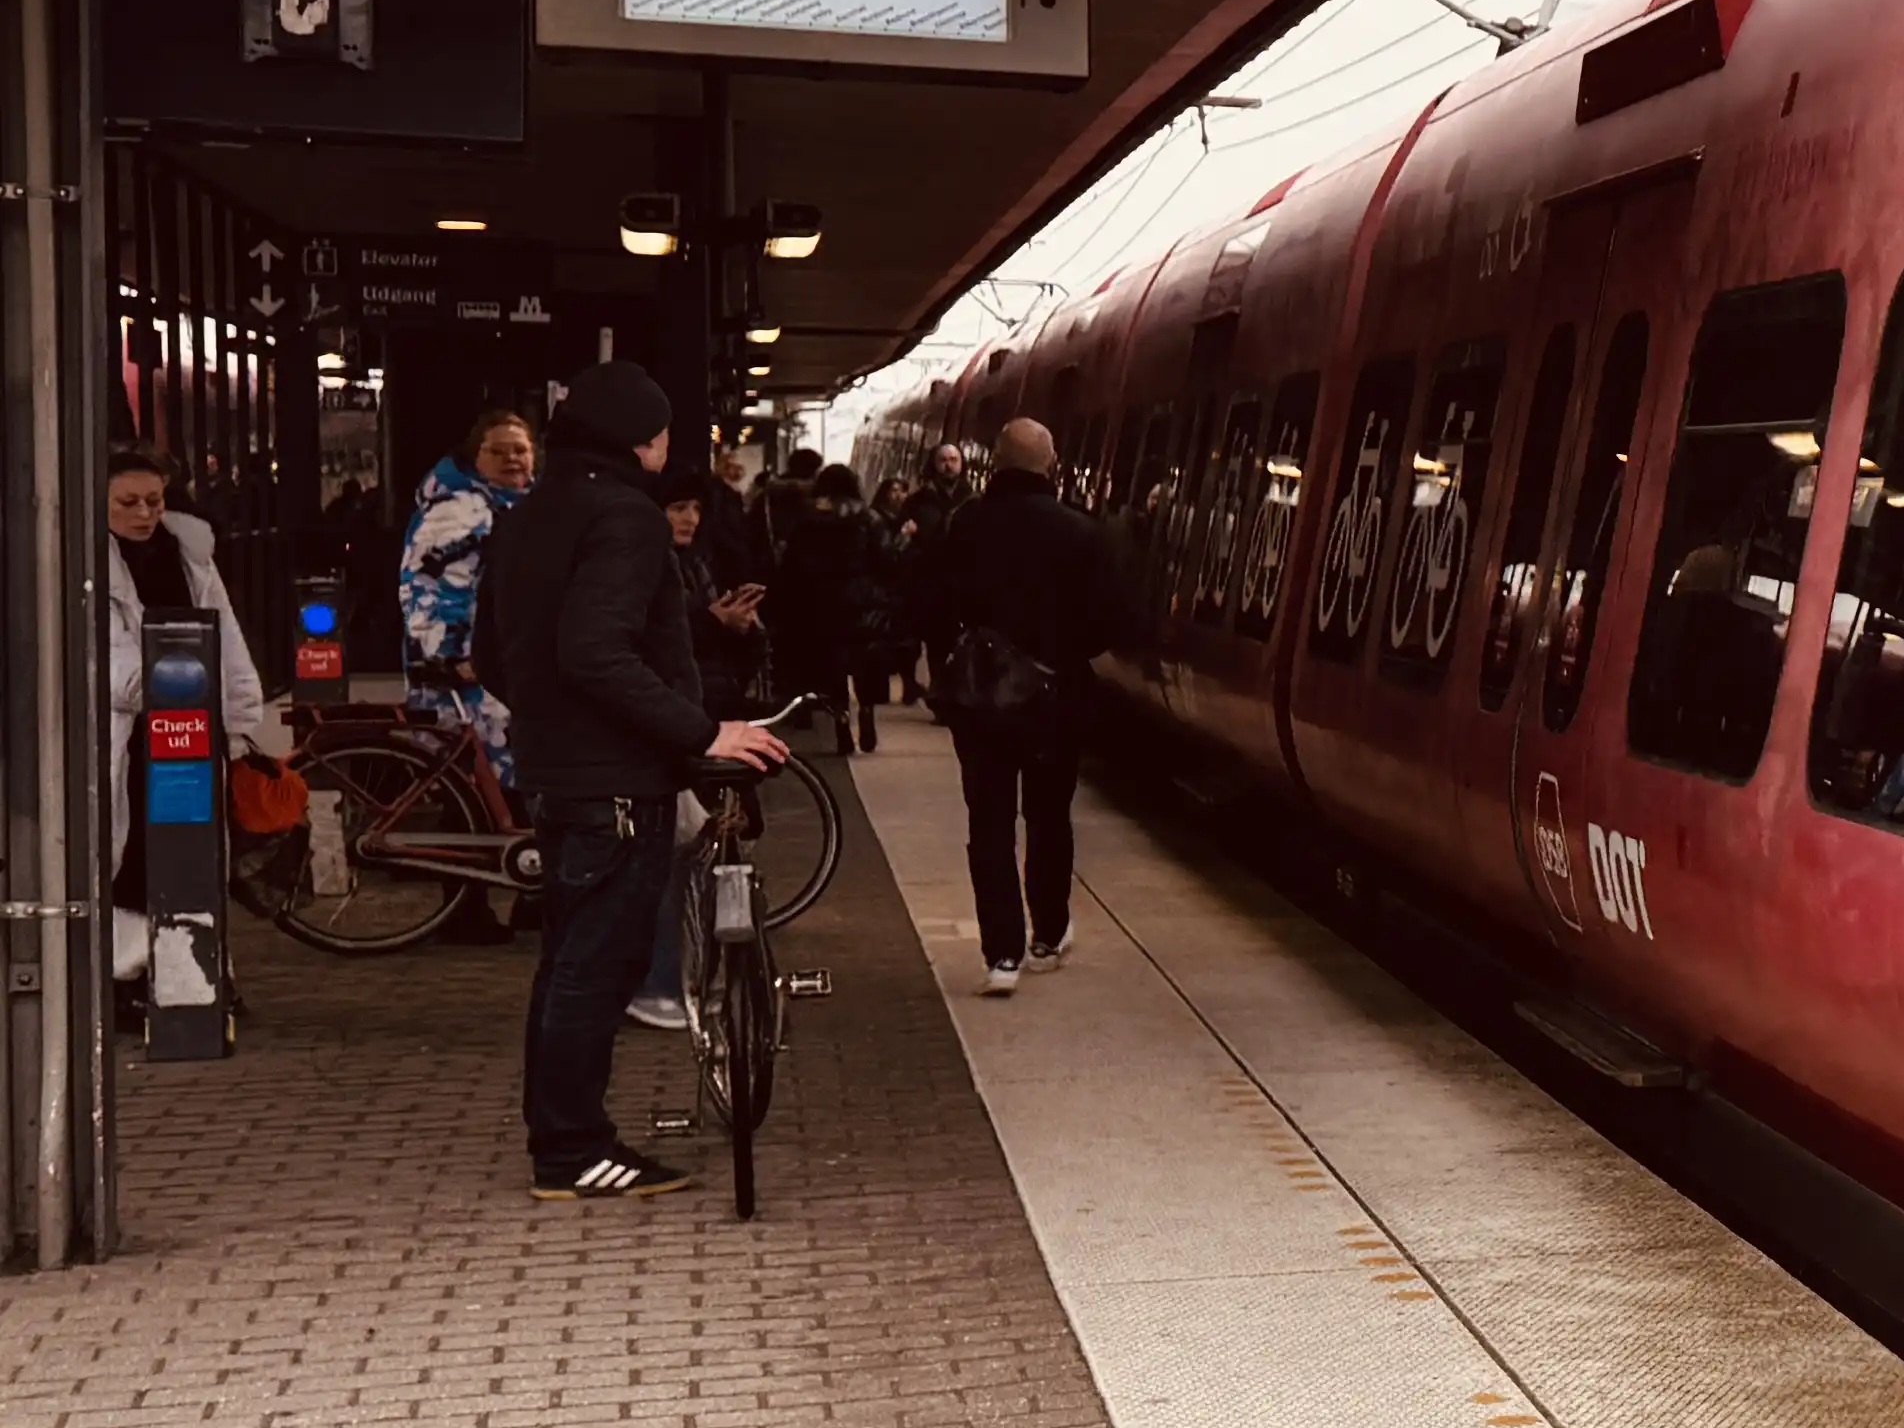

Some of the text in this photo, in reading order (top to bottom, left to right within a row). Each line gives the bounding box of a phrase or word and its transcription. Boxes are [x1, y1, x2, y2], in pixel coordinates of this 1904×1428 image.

[361, 249, 438, 267] Elevator
[363, 286, 437, 305] Udgang
[151, 718, 205, 733] Check
[168, 733, 190, 748] ud
